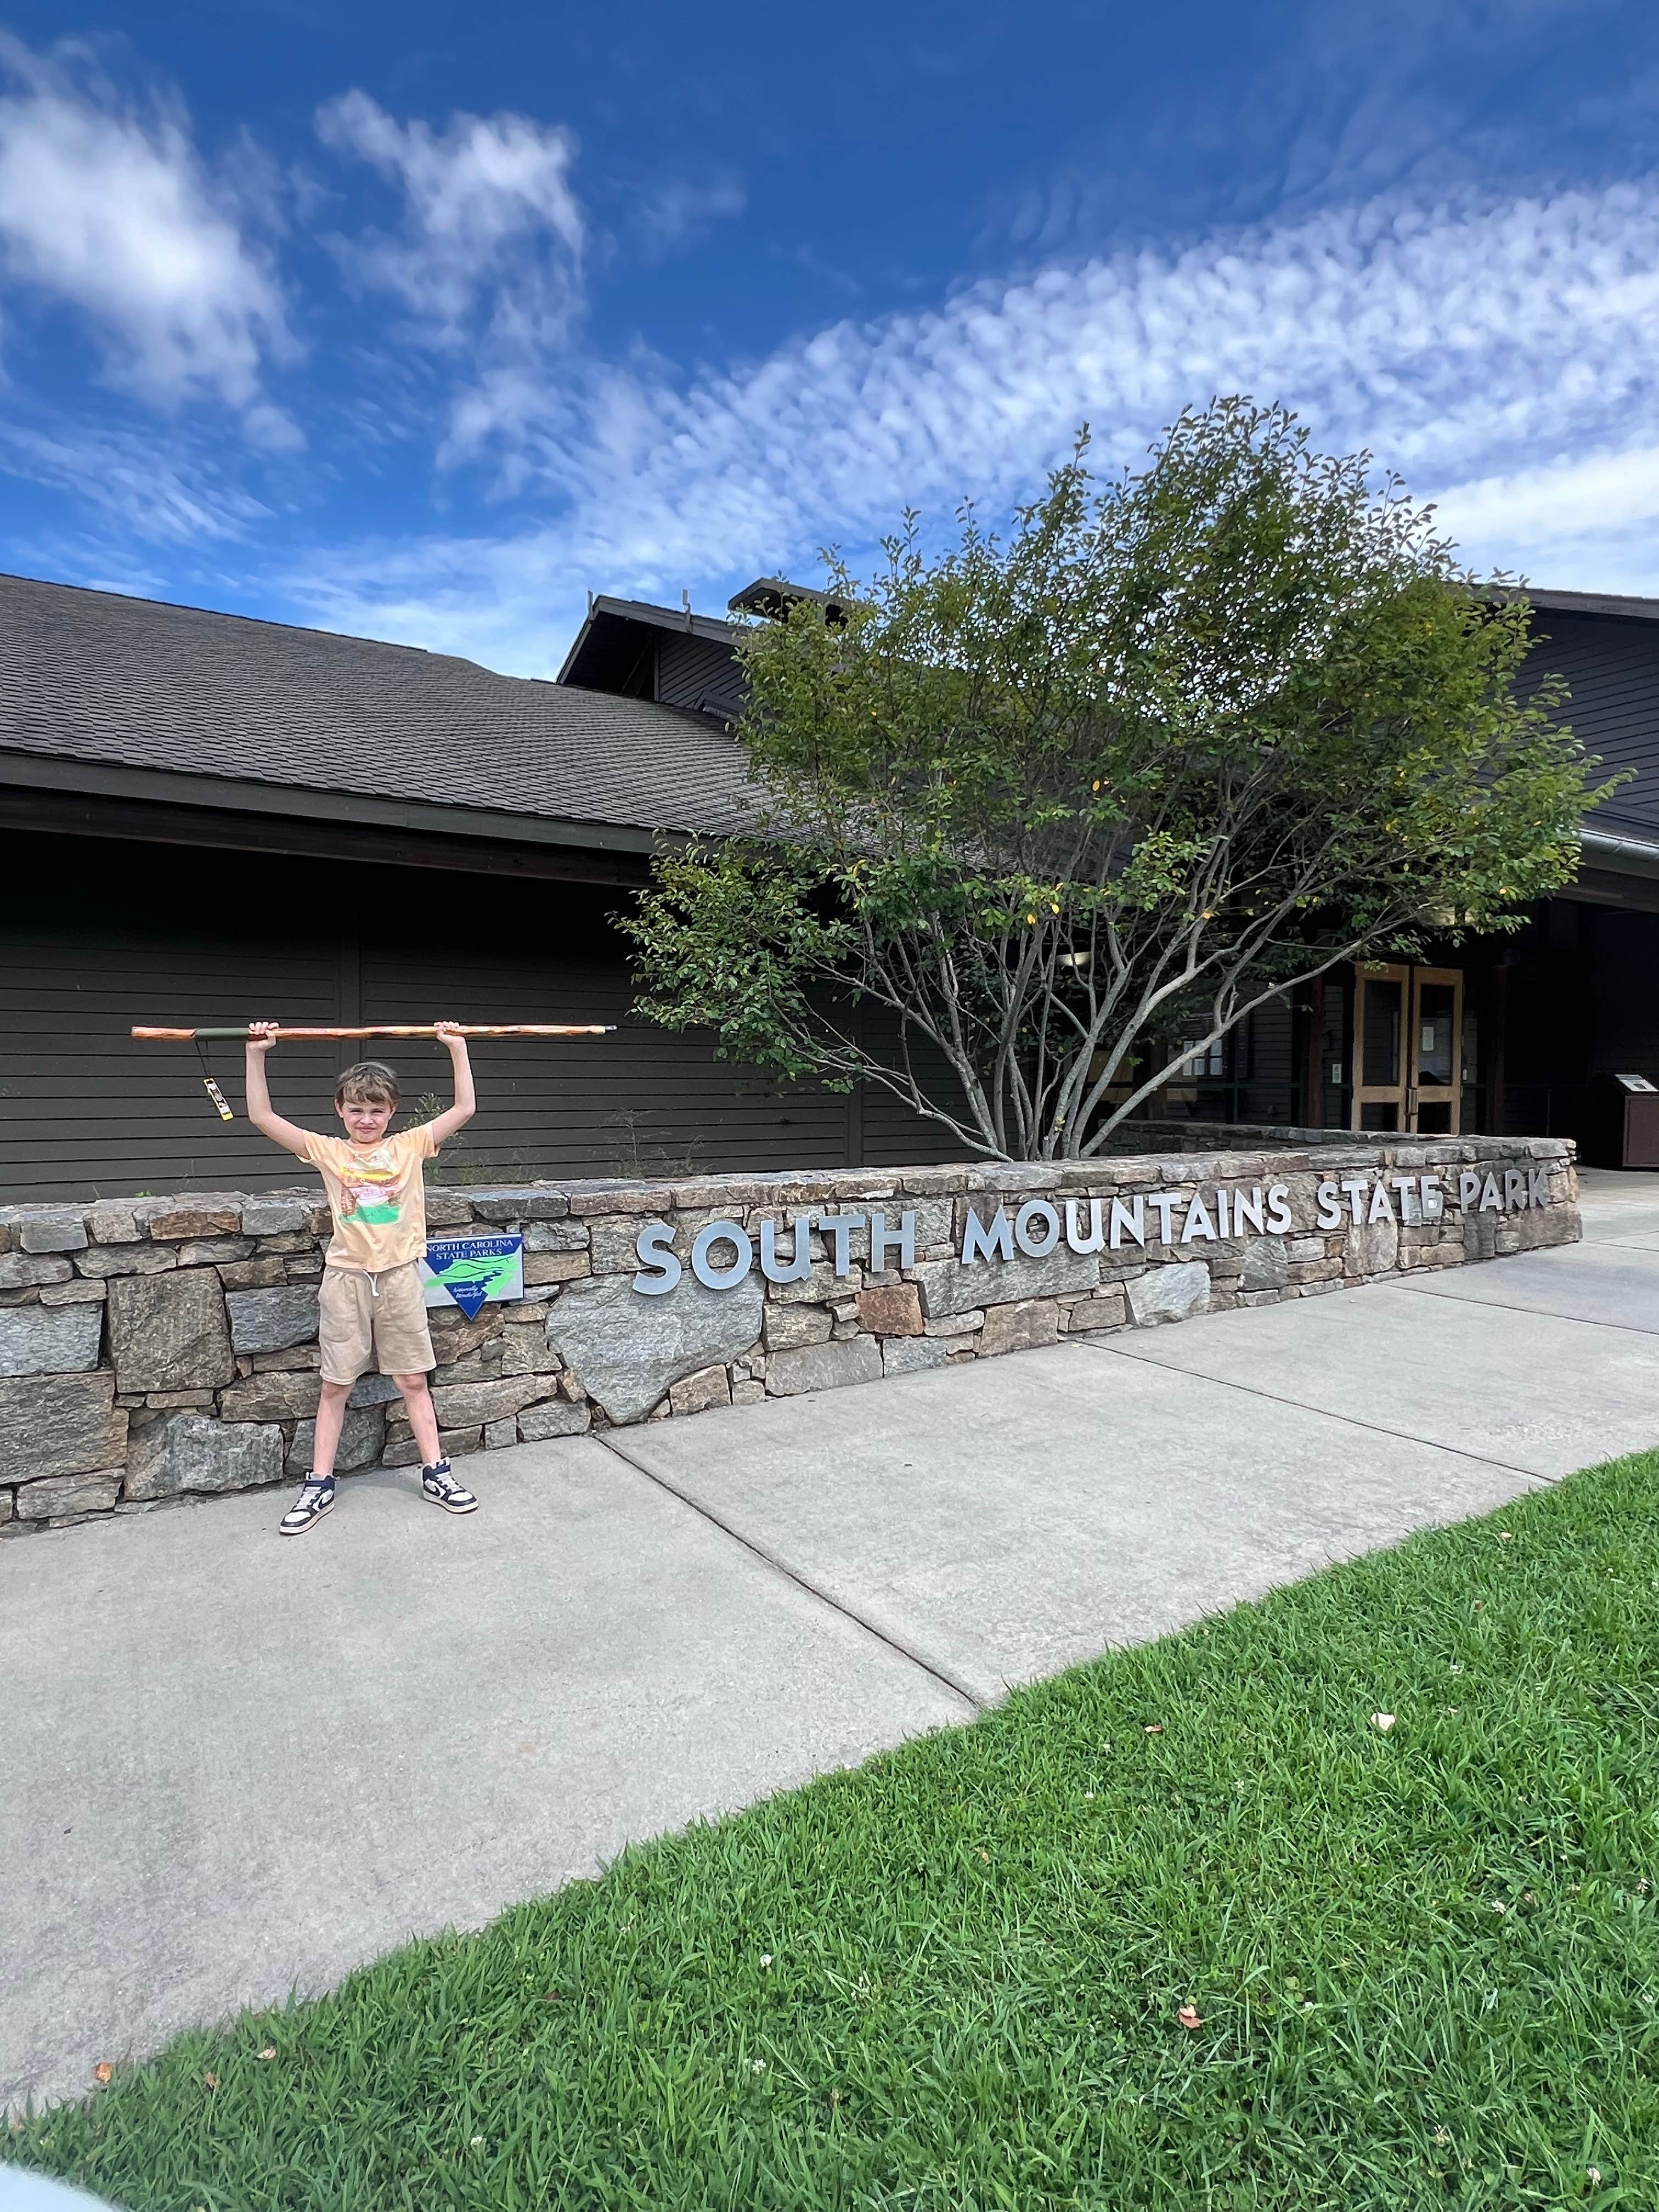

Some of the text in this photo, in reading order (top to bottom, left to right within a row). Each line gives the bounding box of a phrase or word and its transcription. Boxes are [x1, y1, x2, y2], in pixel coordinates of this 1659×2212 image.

[633, 1169, 1550, 1295] SOUTH MOUNTAINS STATE PARK
[427, 1240, 513, 1251] NORTH CAROLINA
[436, 1249, 502, 1260] STATE PARKS
